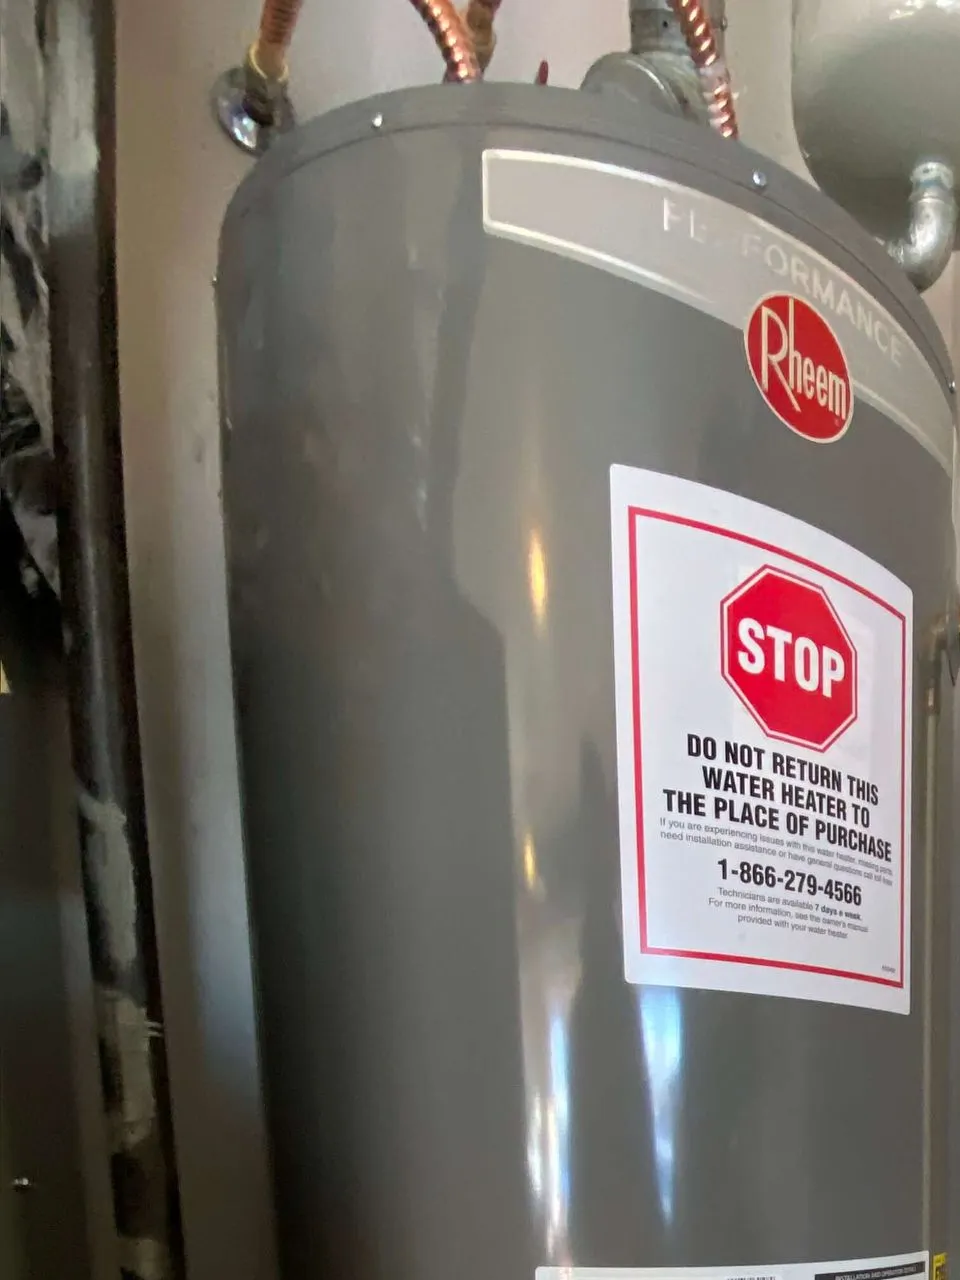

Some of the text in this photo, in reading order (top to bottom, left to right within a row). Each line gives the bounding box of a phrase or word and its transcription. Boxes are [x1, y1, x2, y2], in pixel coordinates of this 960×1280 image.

[762, 298, 845, 420] Rheem
[737, 618, 844, 698] STOP
[688, 734, 878, 806] DO NOT RETURN THIS
[702, 765, 870, 828] WATER HEATER TO
[660, 818, 666, 826] If
[668, 820, 684, 829] you
[688, 823, 702, 831] are
[704, 825, 758, 842] experiencing
[660, 831, 683, 841] need
[686, 834, 732, 848] installation
[734, 841, 776, 856] assistance
[778, 850, 787, 858] or
[663, 789, 892, 862] THE PLACE OF PURCHASE
[718, 858, 862, 906] 1-866-279-4566
[718, 887, 766, 902] Technicians
[768, 896, 780, 905] are
[782, 899, 813, 910] available
[815, 903, 819, 911] 7
[821, 905, 837, 916] days
[708, 897, 723, 907] For
[725, 901, 746, 910] more
[749, 904, 793, 919] information,
[738, 914, 772, 927] provided
[774, 920, 789, 929] with
[791, 923, 807, 933] your
